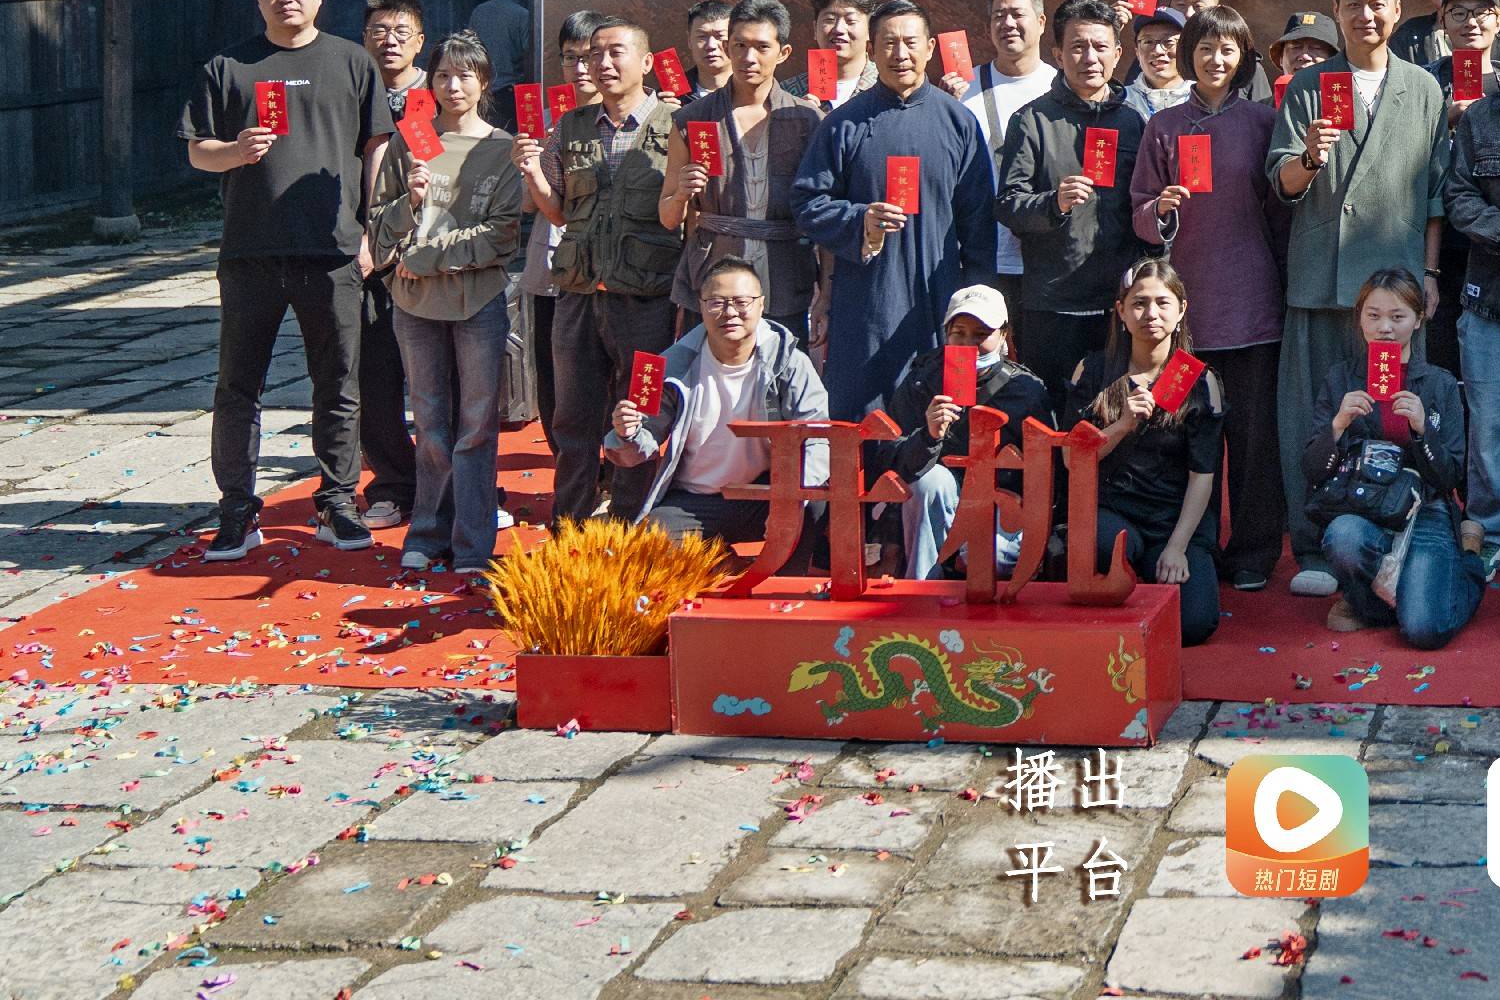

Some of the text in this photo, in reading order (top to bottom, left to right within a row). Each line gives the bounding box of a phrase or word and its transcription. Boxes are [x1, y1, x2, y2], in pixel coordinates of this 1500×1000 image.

[267, 91, 278, 130] 开机大吉
[1331, 83, 1345, 125] 开机大吉
[699, 131, 712, 170] 开机大吉
[639, 363, 654, 407] 开机大吉
[1379, 351, 1391, 395] 开机大吉
[722, 406, 1137, 606] 开机
